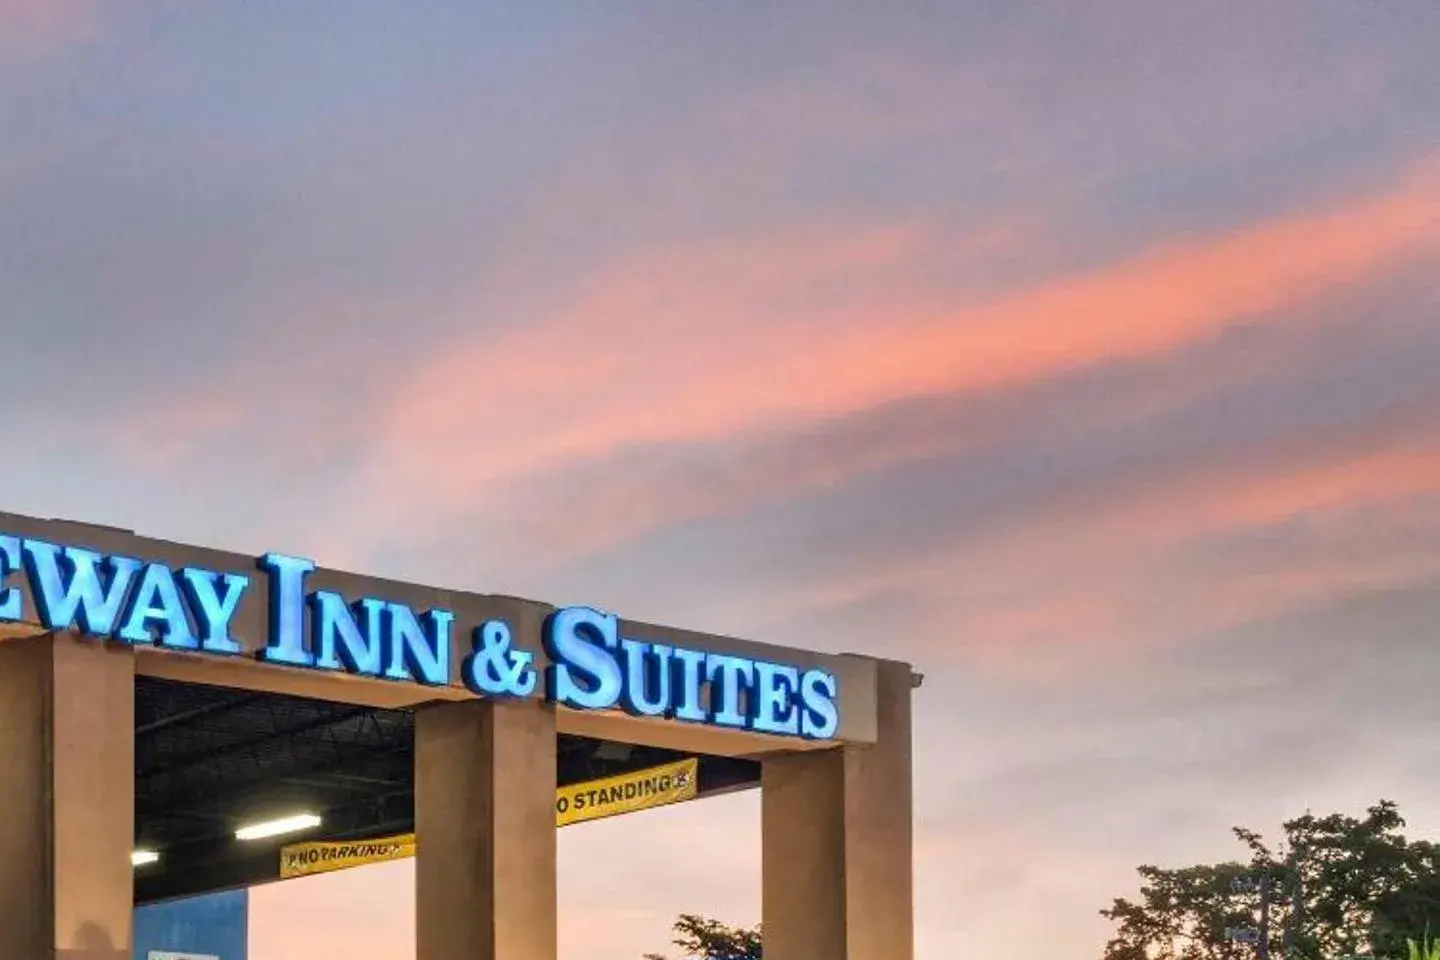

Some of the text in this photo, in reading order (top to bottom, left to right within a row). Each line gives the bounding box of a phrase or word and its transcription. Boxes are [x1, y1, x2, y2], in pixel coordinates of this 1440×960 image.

[257, 552, 454, 686] INN
[463, 618, 537, 698] &
[543, 604, 839, 741] SUITES
[574, 775, 671, 809] STANDING
[298, 844, 387, 865] NO PARKING
